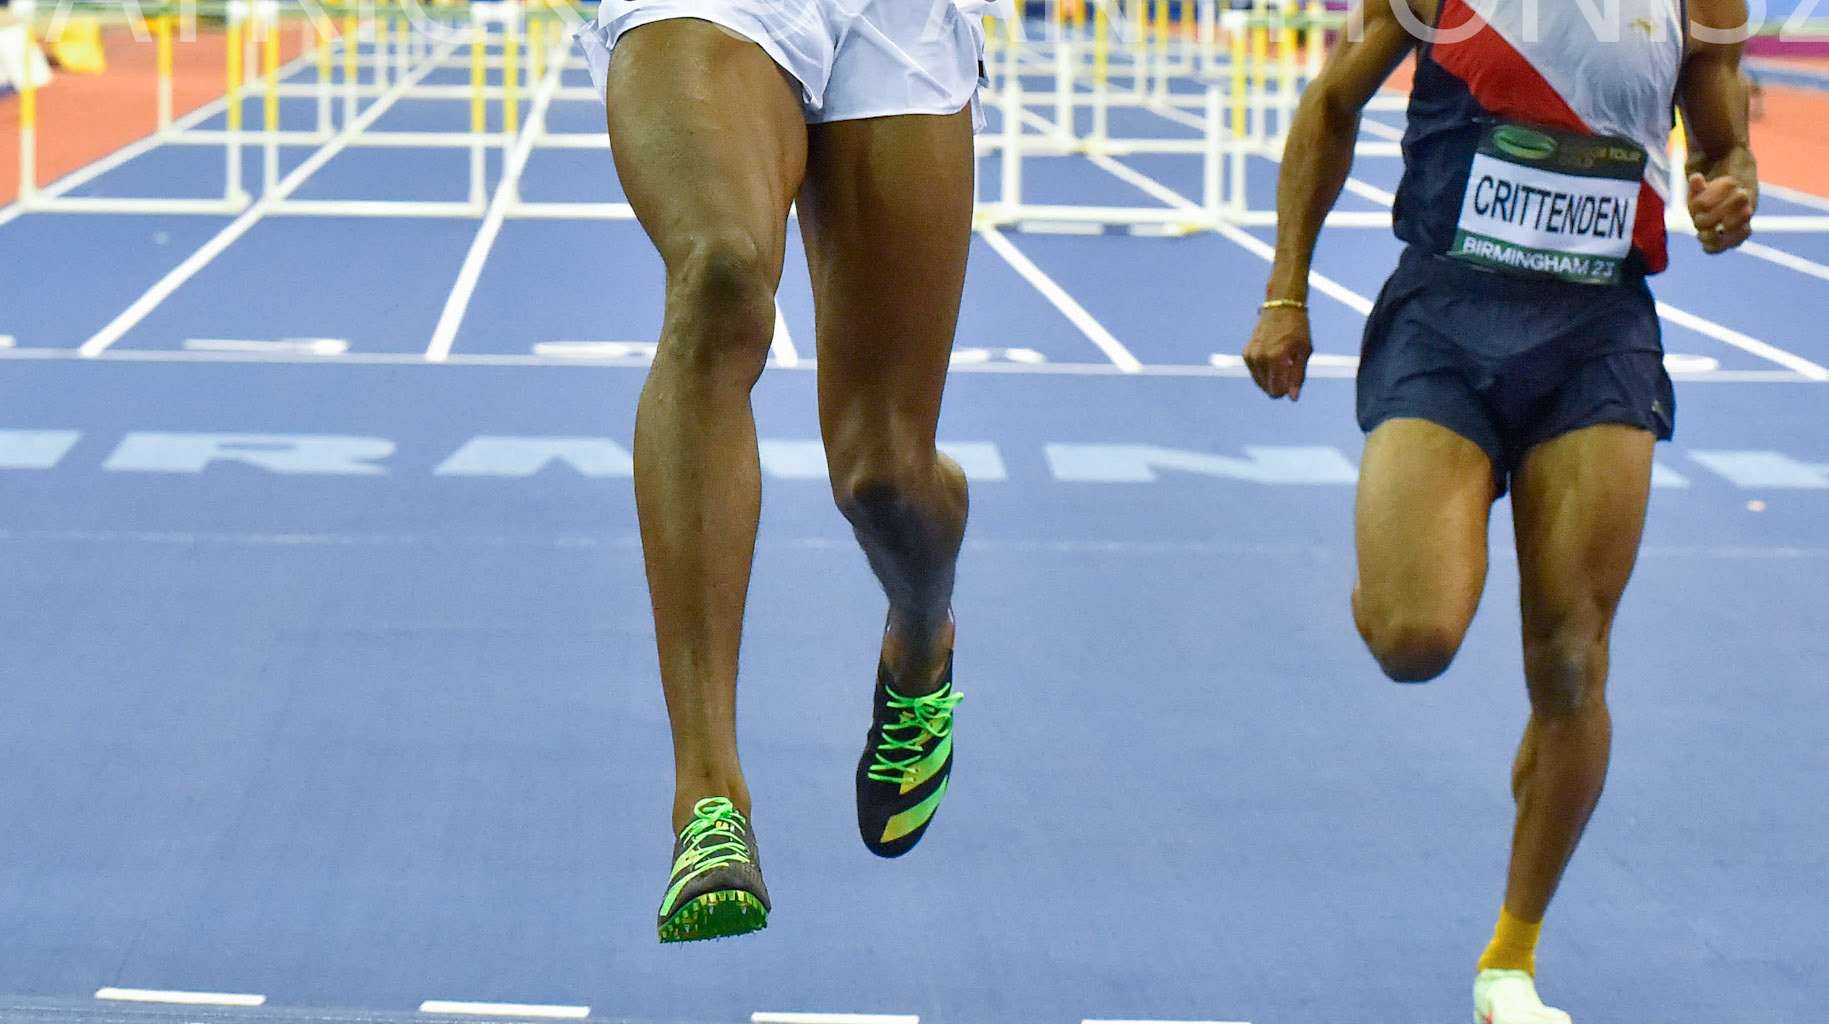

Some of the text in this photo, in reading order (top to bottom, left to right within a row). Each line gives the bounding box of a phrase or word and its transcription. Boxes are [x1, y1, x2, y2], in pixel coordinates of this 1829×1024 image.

[1474, 176, 1629, 239] CRITTENDEN
[1462, 236, 1615, 277] BIRMINGHAM 23
